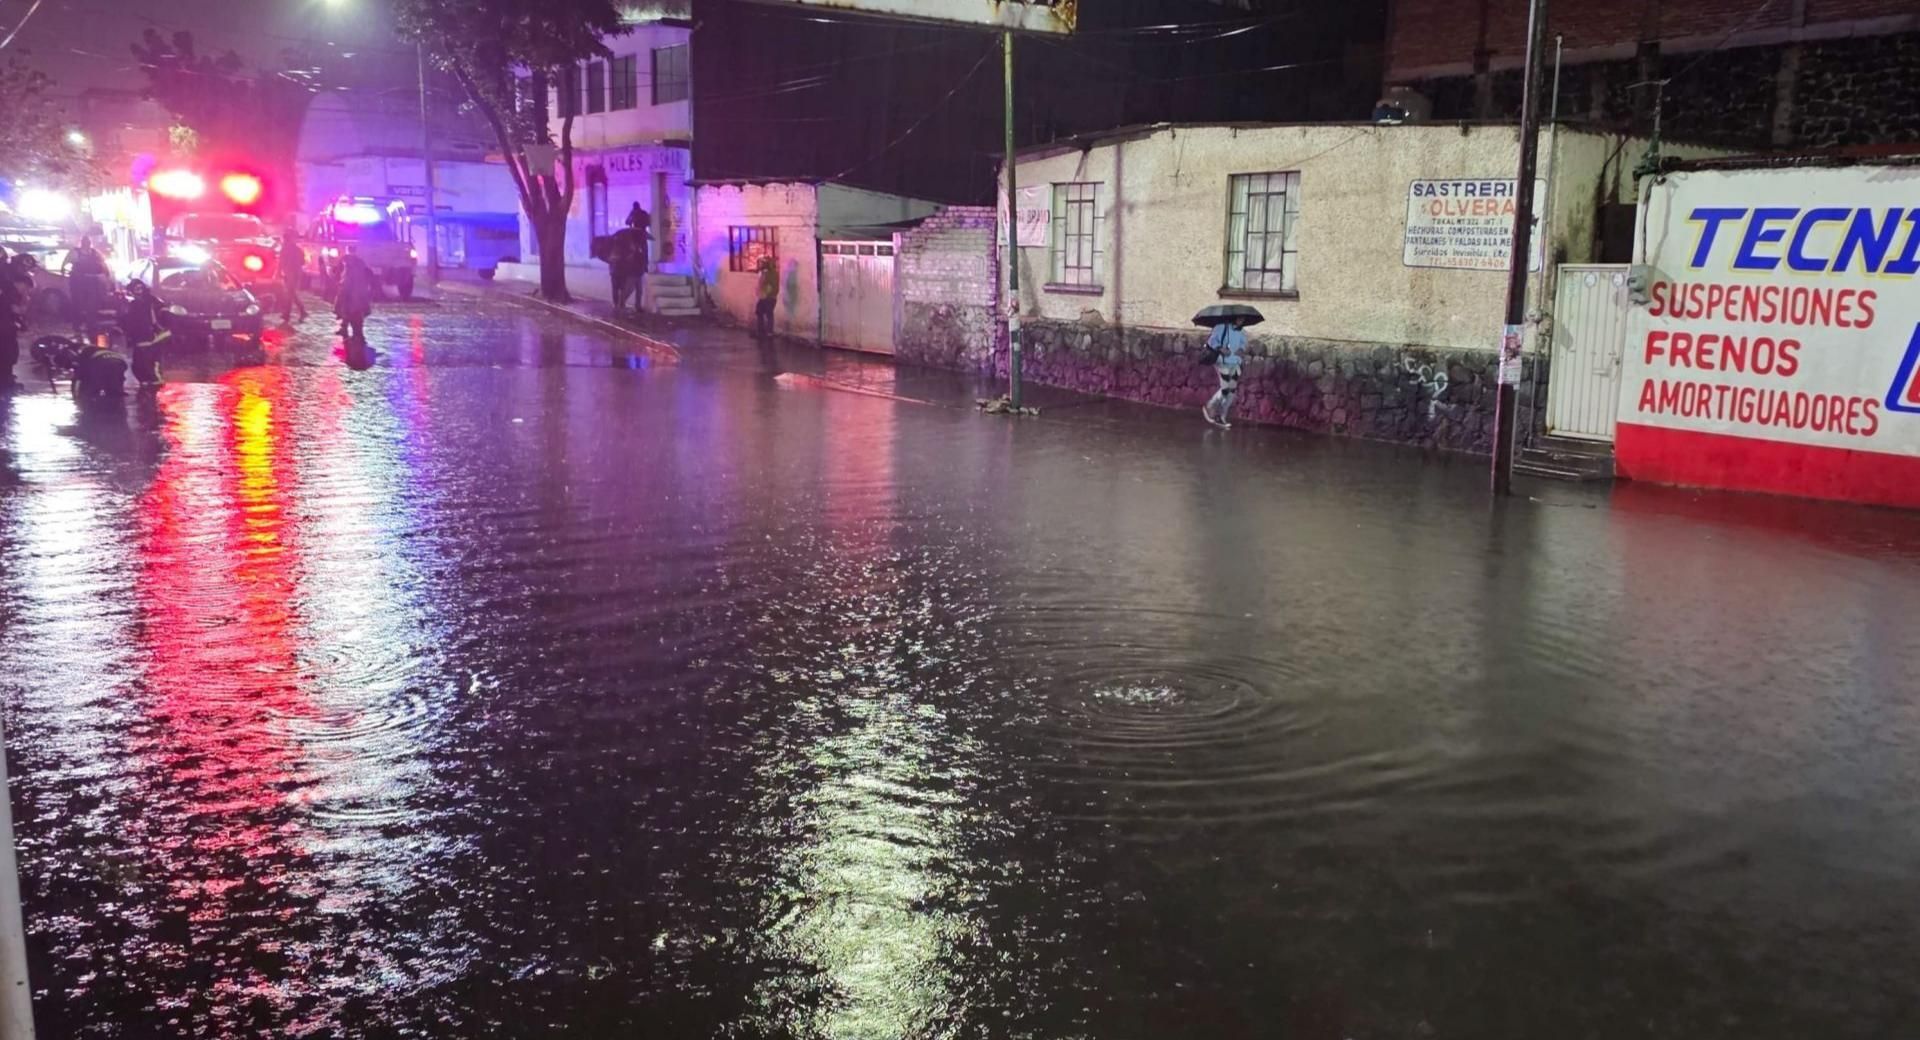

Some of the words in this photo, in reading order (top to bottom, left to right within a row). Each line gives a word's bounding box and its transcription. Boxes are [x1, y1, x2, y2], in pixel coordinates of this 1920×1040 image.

[1413, 182, 1515, 197] SASTRERI
[1430, 199, 1515, 216] OLVERA
[1648, 281, 1878, 329] SUSPENSIONES
[1645, 330, 1802, 377] FRENOS
[1638, 378, 1880, 437] AMORTIGUADORES
